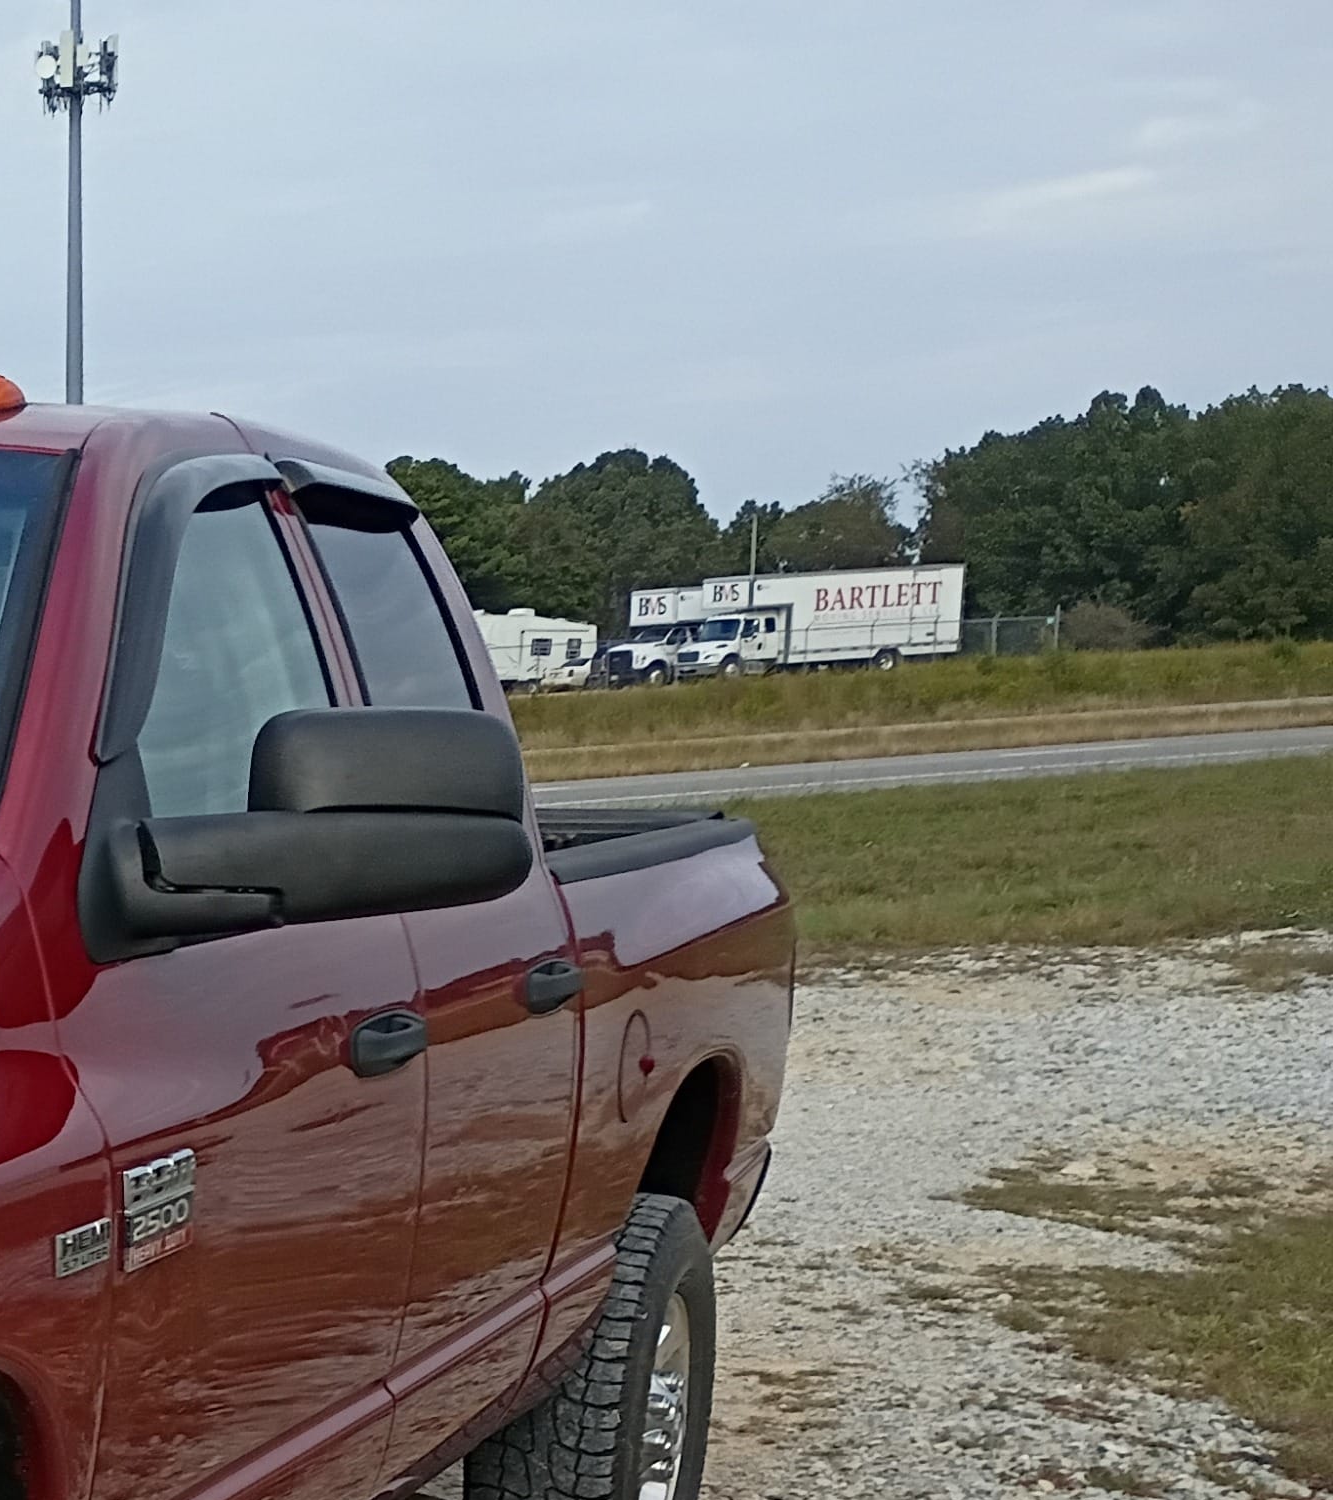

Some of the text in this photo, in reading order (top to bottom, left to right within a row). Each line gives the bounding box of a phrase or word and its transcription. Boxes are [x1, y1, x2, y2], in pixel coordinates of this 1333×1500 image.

[814, 580, 943, 612] BARTLETT
[59, 1220, 111, 1260] HEMI
[132, 1198, 190, 1242] 2500
